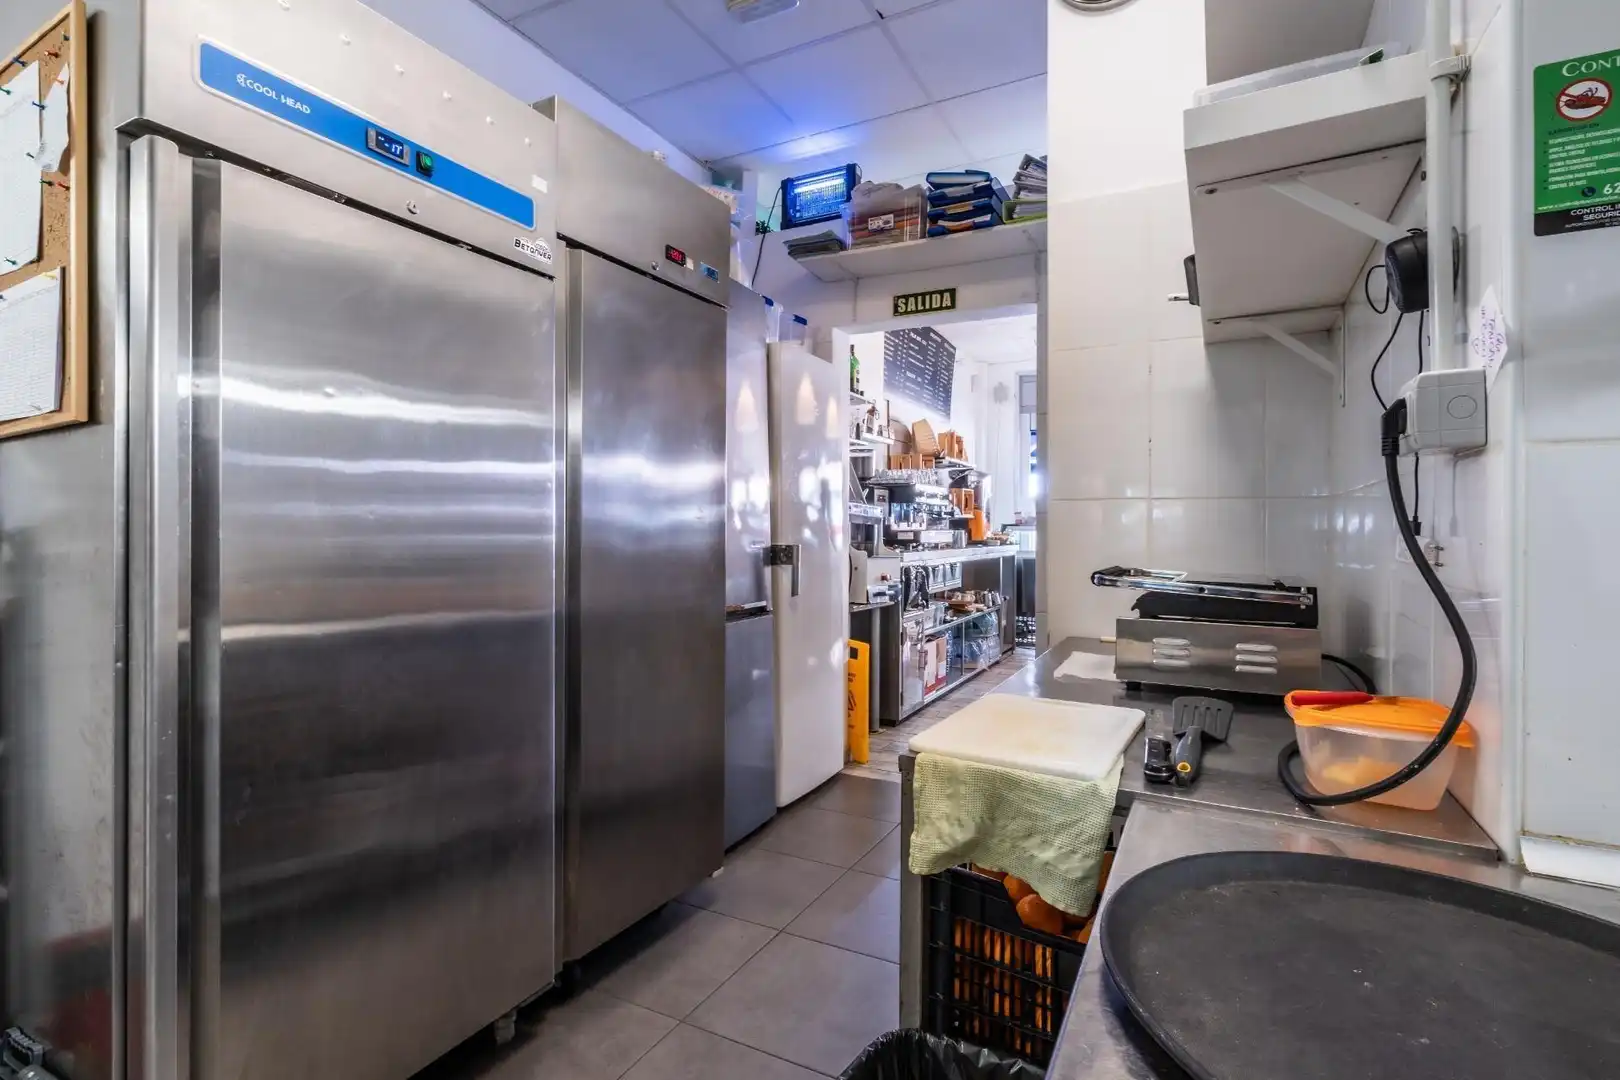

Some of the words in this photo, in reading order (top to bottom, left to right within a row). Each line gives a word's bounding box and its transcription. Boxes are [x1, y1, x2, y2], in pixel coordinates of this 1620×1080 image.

[246, 79, 278, 101] COOL
[280, 94, 311, 114] HEAD
[1570, 204, 1614, 216] CONTROL
[897, 292, 952, 313] SALIDA
